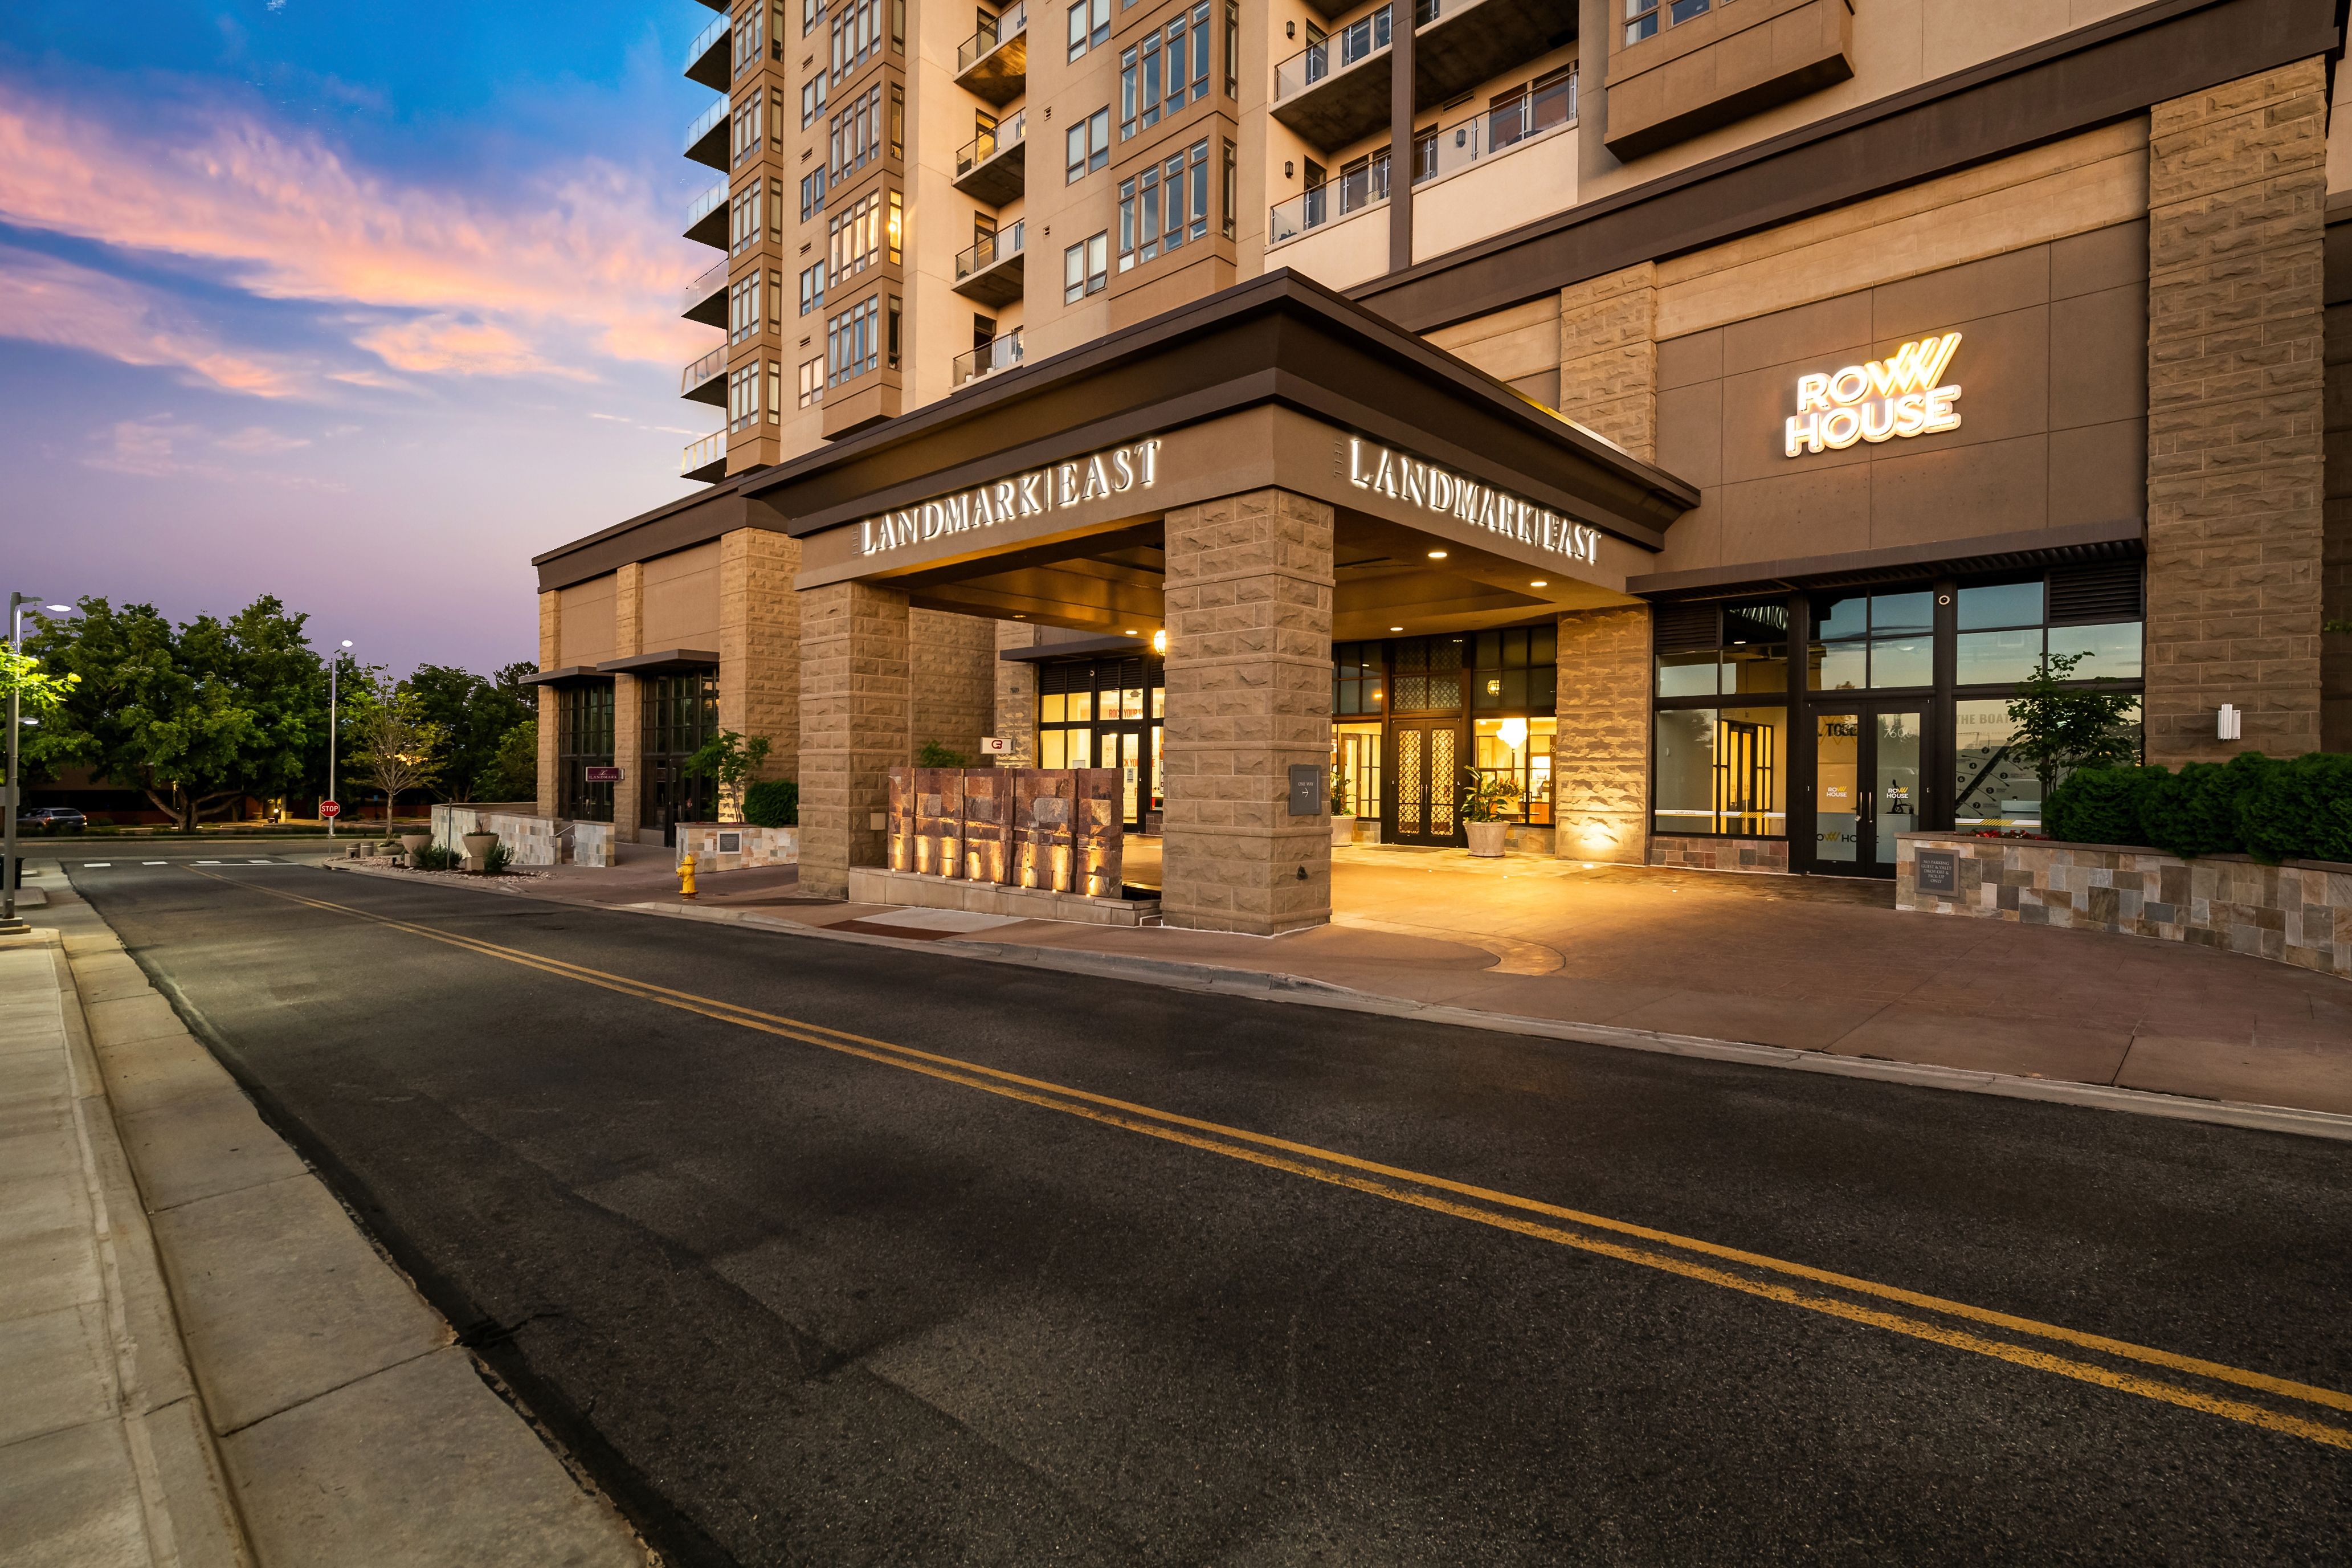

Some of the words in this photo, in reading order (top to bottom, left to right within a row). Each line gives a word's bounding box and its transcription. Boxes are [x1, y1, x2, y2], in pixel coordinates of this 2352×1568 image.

[1798, 332, 1962, 413] ROW
[1785, 384, 1962, 458] HOUSE
[860, 475, 1042, 554] LANDMARK
[1056, 440, 1161, 507] EAST
[1350, 439, 1537, 545] LANDMARK
[1543, 510, 1602, 566] EAST
[1884, 728, 1913, 738] 7600
[1817, 831, 1841, 842] OW
